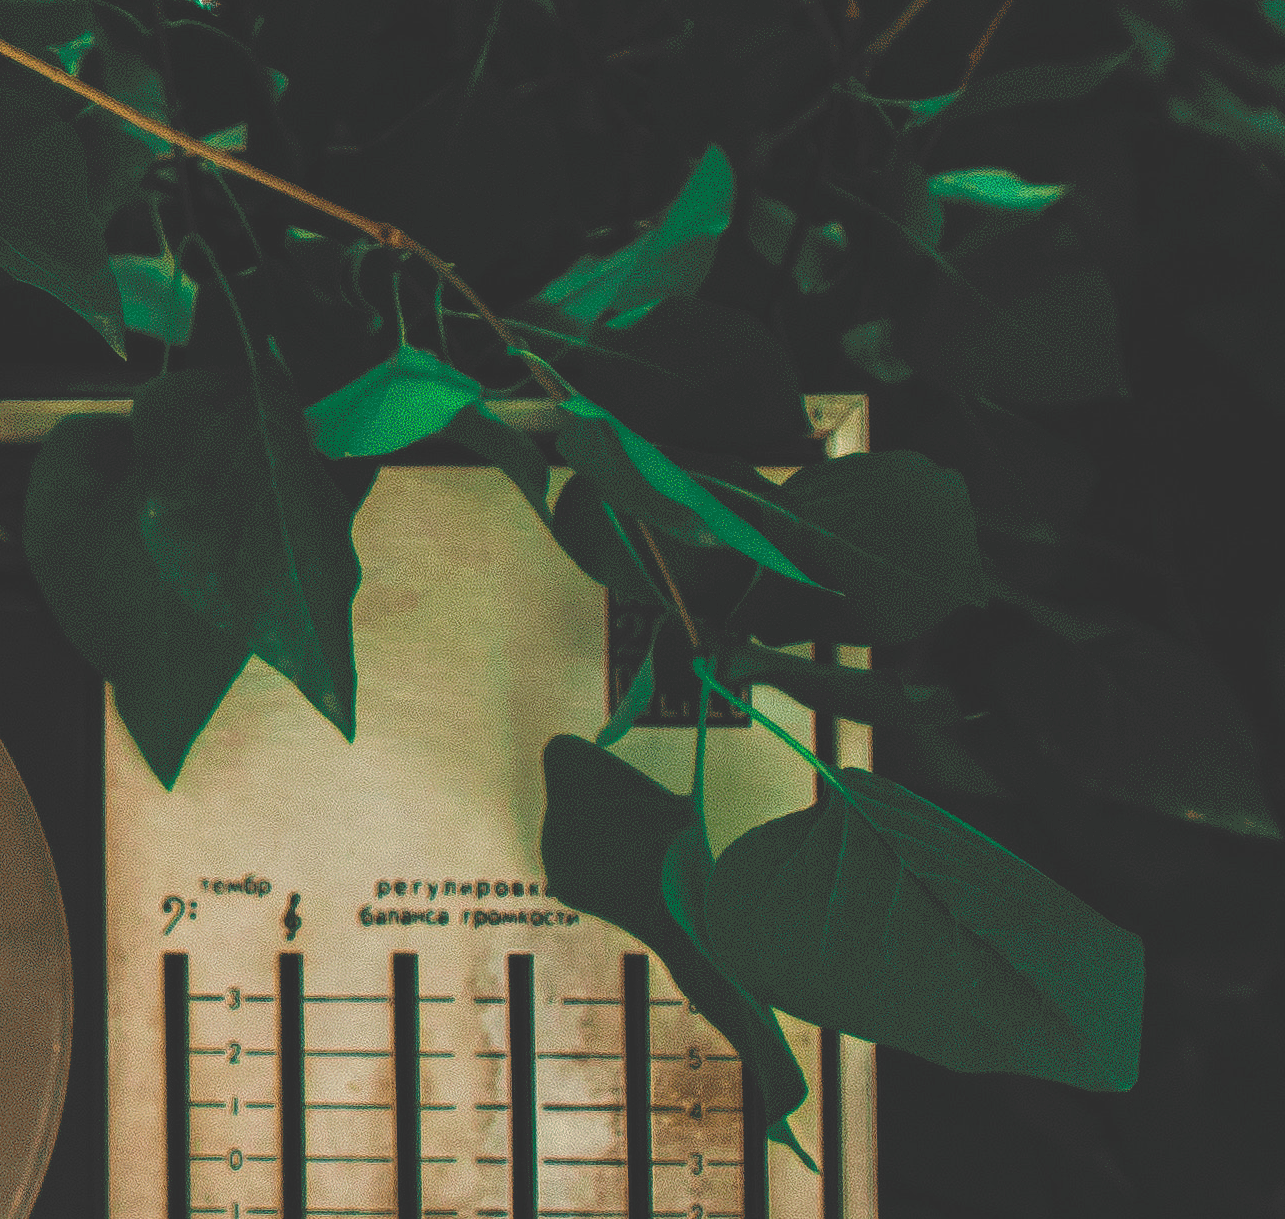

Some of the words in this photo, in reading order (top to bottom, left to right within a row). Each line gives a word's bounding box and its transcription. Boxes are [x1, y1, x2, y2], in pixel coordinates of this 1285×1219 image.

[202, 876, 271, 897] тембр
[377, 880, 555, 899] регулировк
[359, 906, 449, 926] баланса
[462, 908, 580, 929] громкости
[228, 988, 241, 1010] 3
[229, 1042, 241, 1064] 2
[688, 1048, 702, 1070] 5
[229, 1149, 243, 1171] 0
[690, 1153, 703, 1175] 3
